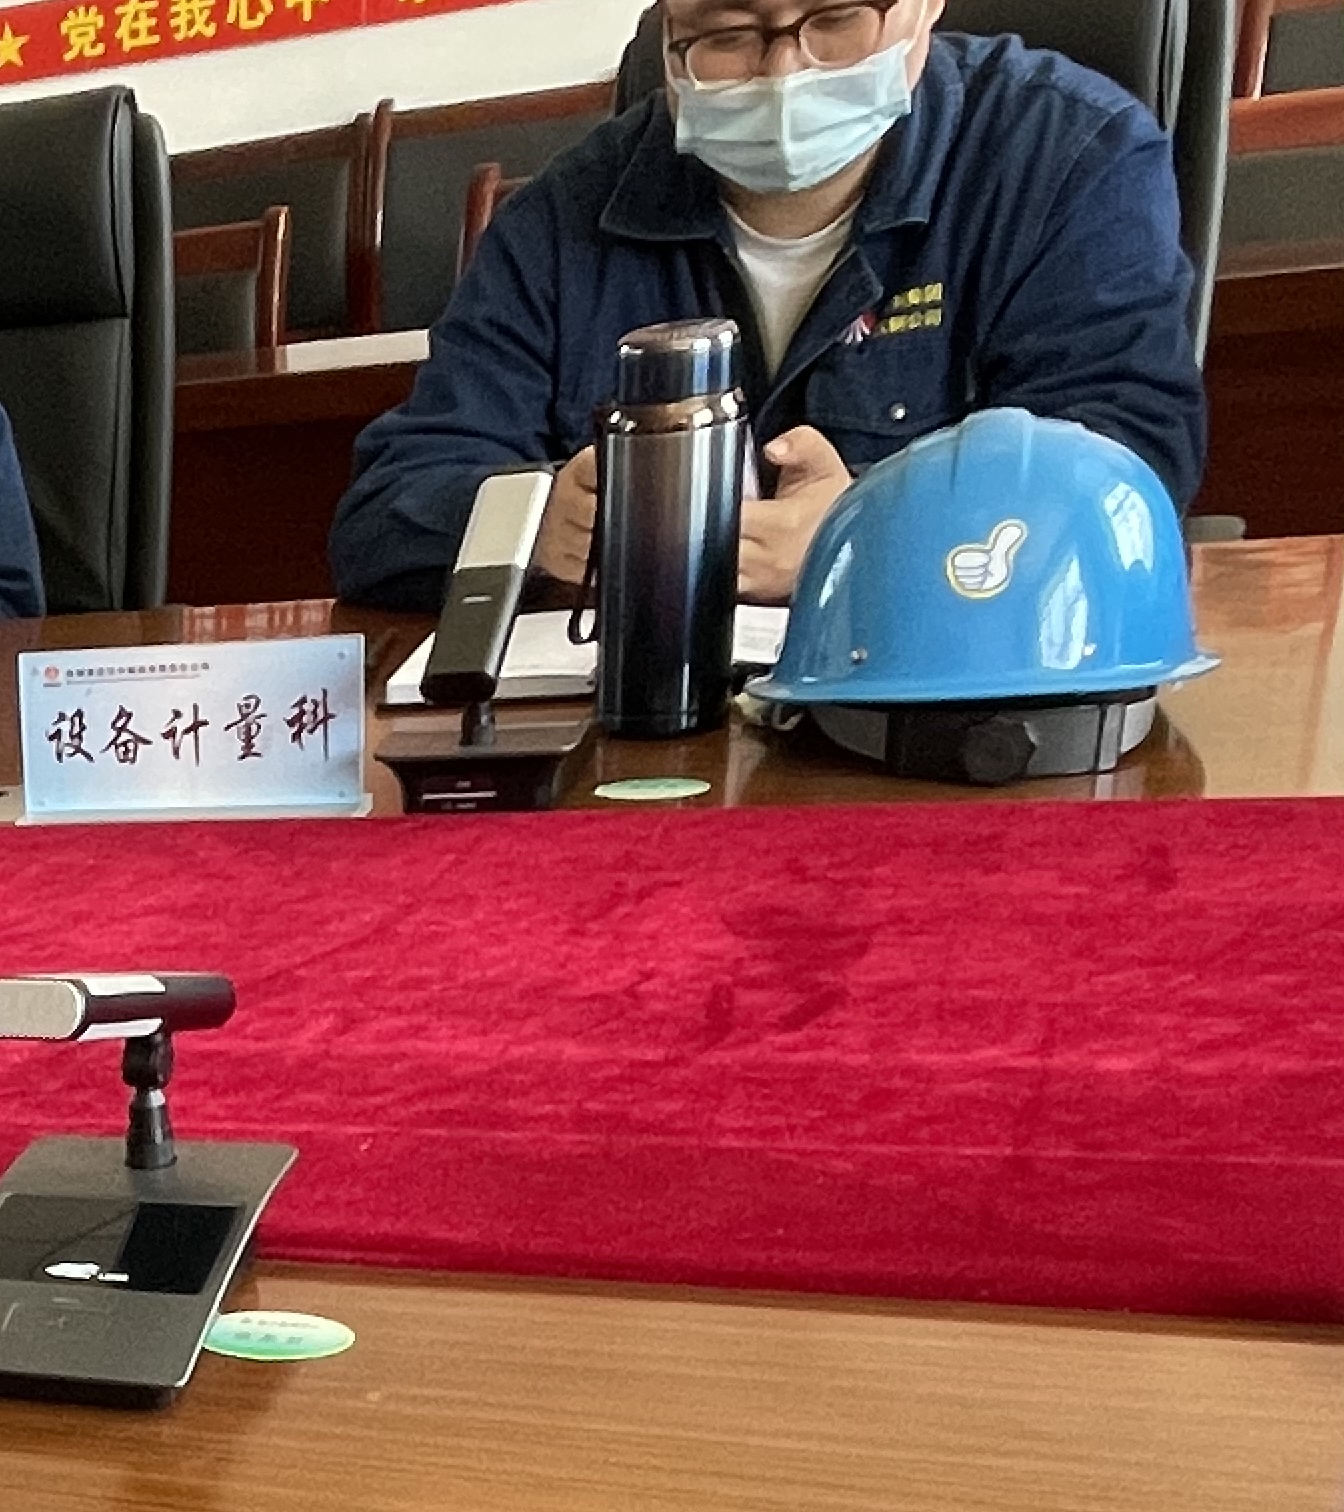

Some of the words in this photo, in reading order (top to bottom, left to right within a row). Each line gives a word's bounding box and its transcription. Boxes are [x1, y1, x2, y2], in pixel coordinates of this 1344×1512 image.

[45, 687, 337, 767] 设备计量科
